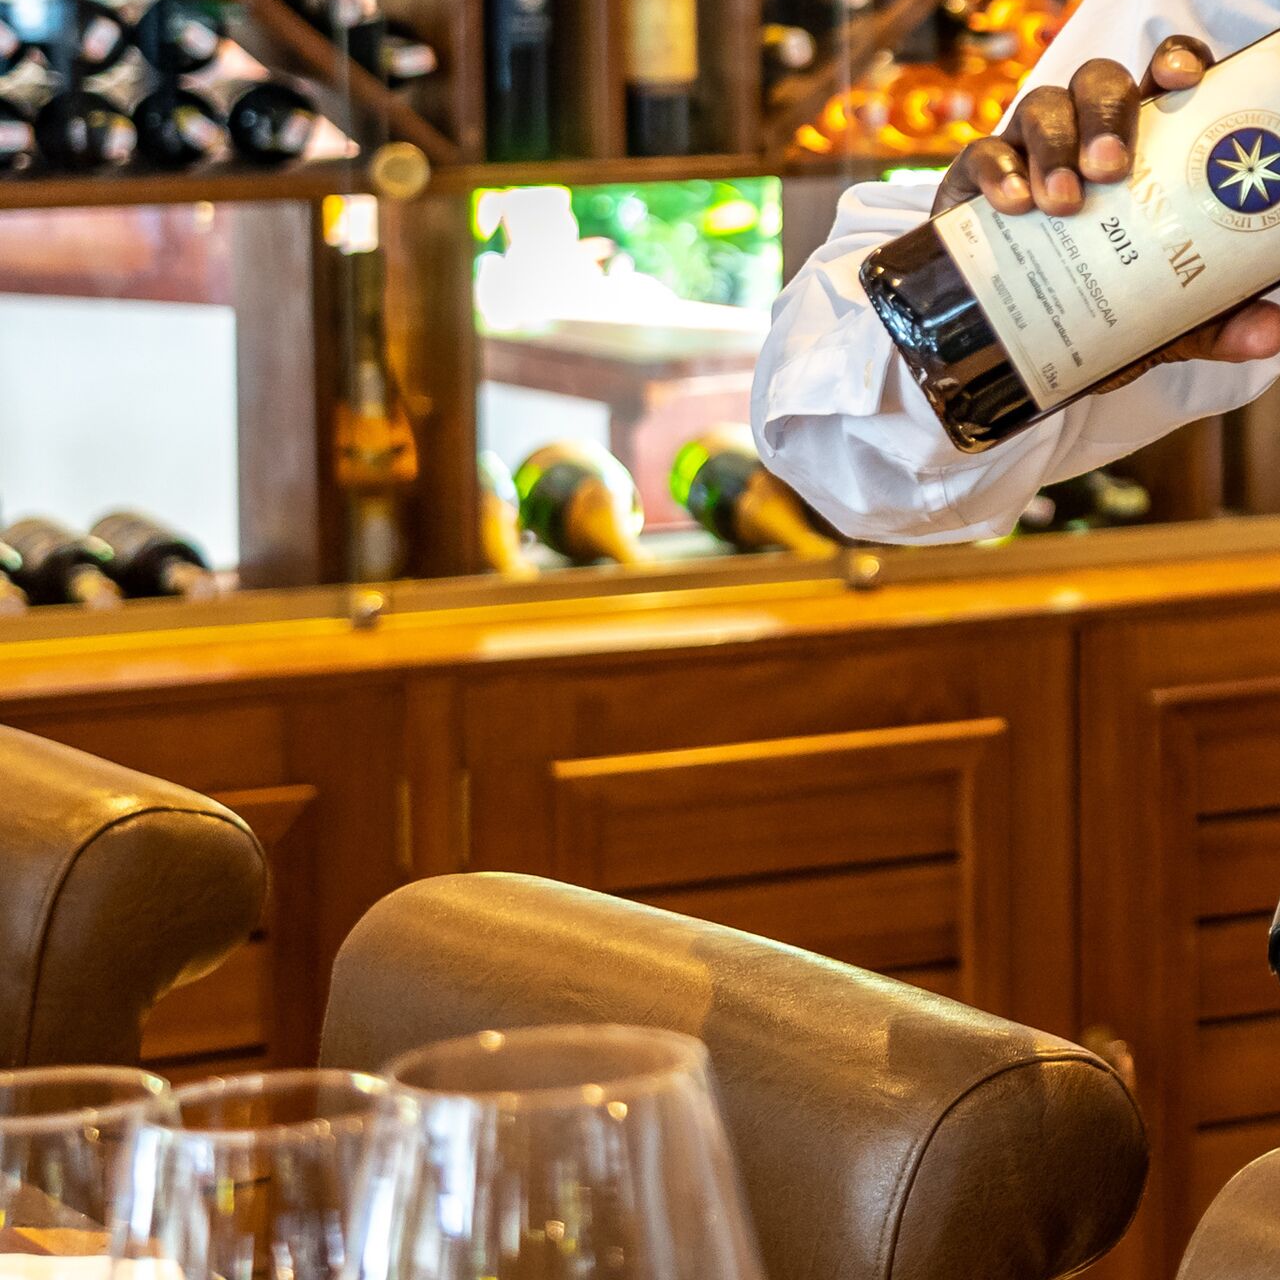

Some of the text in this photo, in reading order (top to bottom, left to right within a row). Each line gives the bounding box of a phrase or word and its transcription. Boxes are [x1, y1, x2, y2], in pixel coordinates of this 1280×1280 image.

[1009, 241, 1028, 266] Guido
[1022, 269, 1056, 318] Castagneto
[1049, 314, 1074, 348] Carducci
[1047, 211, 1120, 329] LGHERI SASSICAIA
[1099, 214, 1141, 268] 2013
